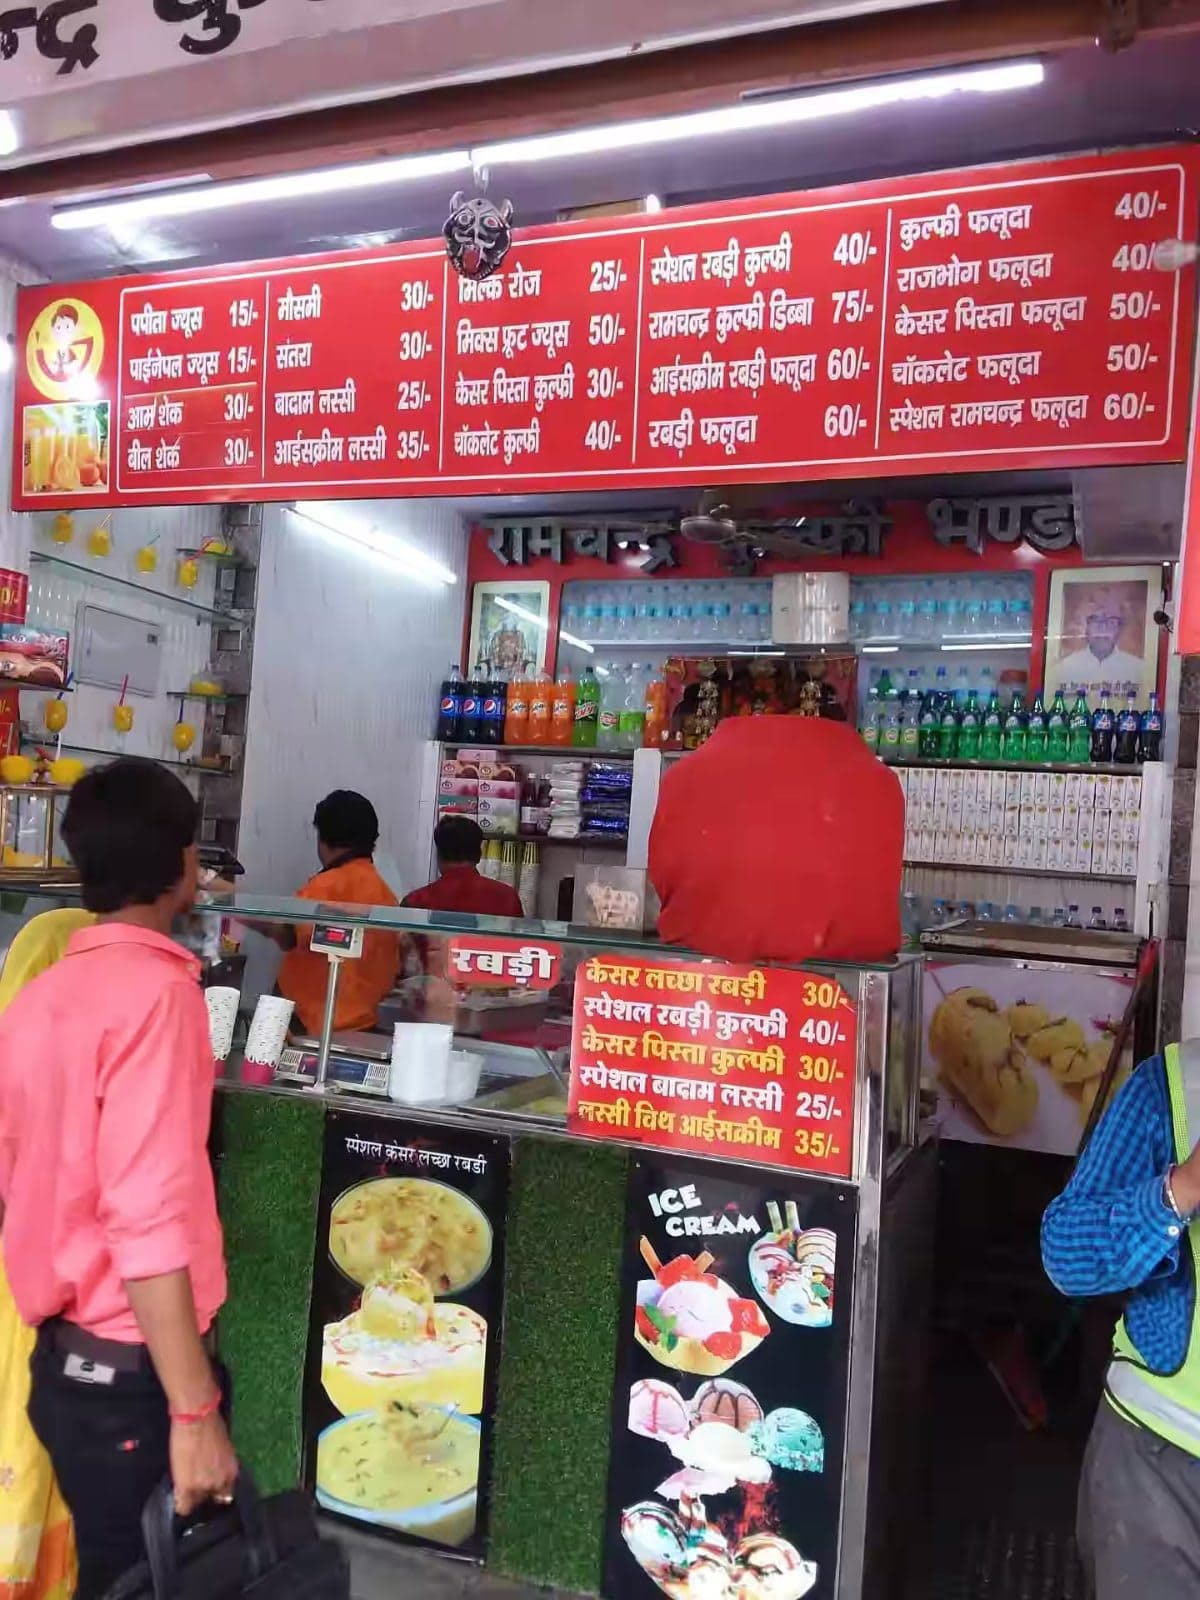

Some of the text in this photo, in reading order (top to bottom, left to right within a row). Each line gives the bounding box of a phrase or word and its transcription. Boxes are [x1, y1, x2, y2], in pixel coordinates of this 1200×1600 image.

[900, 191, 1167, 252] कुल्फी फलूदा 40/-
[508, 261, 542, 299] रोज
[589, 259, 627, 294] 25/-
[651, 231, 877, 288] स्पेशल रबड़ी कुल्फी 40/-
[897, 242, 1156, 292] राजभोग फलूदा 40/
[130, 299, 259, 339] पपीता ज्यूस 15/-
[277, 280, 434, 320] मौसमी 30/-
[648, 288, 874, 344] रामचन्द्र कुल्फी डिब्बा 75/-
[895, 290, 1161, 337] केसर पिस्ता फलूदा 50/-
[276, 331, 433, 369] संतरा 30/-
[457, 317, 498, 355] मिक्स
[530, 319, 570, 358] ज्यूस
[588, 314, 626, 346] 50/-
[186, 351, 220, 385] ज्यूस
[227, 346, 258, 373] 15/-
[651, 346, 871, 398] आईसक्रीम रबड़ी फलूदा 60/-
[891, 342, 1158, 386] चॉकलेट फलूदा 50/-
[224, 393, 254, 421] 30/-
[275, 378, 432, 416] बादाम लस्सी 25/-
[455, 361, 624, 412] केसर पिस्ता कुल्फी 30/-
[648, 404, 868, 458] रबड़ी फलूदा 60/-
[889, 391, 1156, 433] स्पेशल रामचन्द्र फलूदा 60/-
[224, 437, 254, 466] 30/-
[274, 425, 430, 466] आईसक्रीम लस्सी 35/-
[454, 416, 622, 465] चॉकलेट कुल्फी 40/-
[451, 946, 556, 985] रबड़ी
[586, 958, 849, 1008] केसर लच्छा रबड़ी 30/-
[583, 991, 847, 1047] स्पेशल रबड़ी कुल्फी 40/-
[581, 1024, 845, 1083] केसर पिस्ता कुल्फी 30/-
[579, 1060, 843, 1121] स्पेशल बादाम लस्सी 25/-
[577, 1096, 630, 1127] लस्सी
[678, 1110, 783, 1150] आईसक्रीम
[794, 1128, 841, 1157] 35/-
[648, 1183, 702, 1217] ICE
[665, 1213, 761, 1238] CREAM
